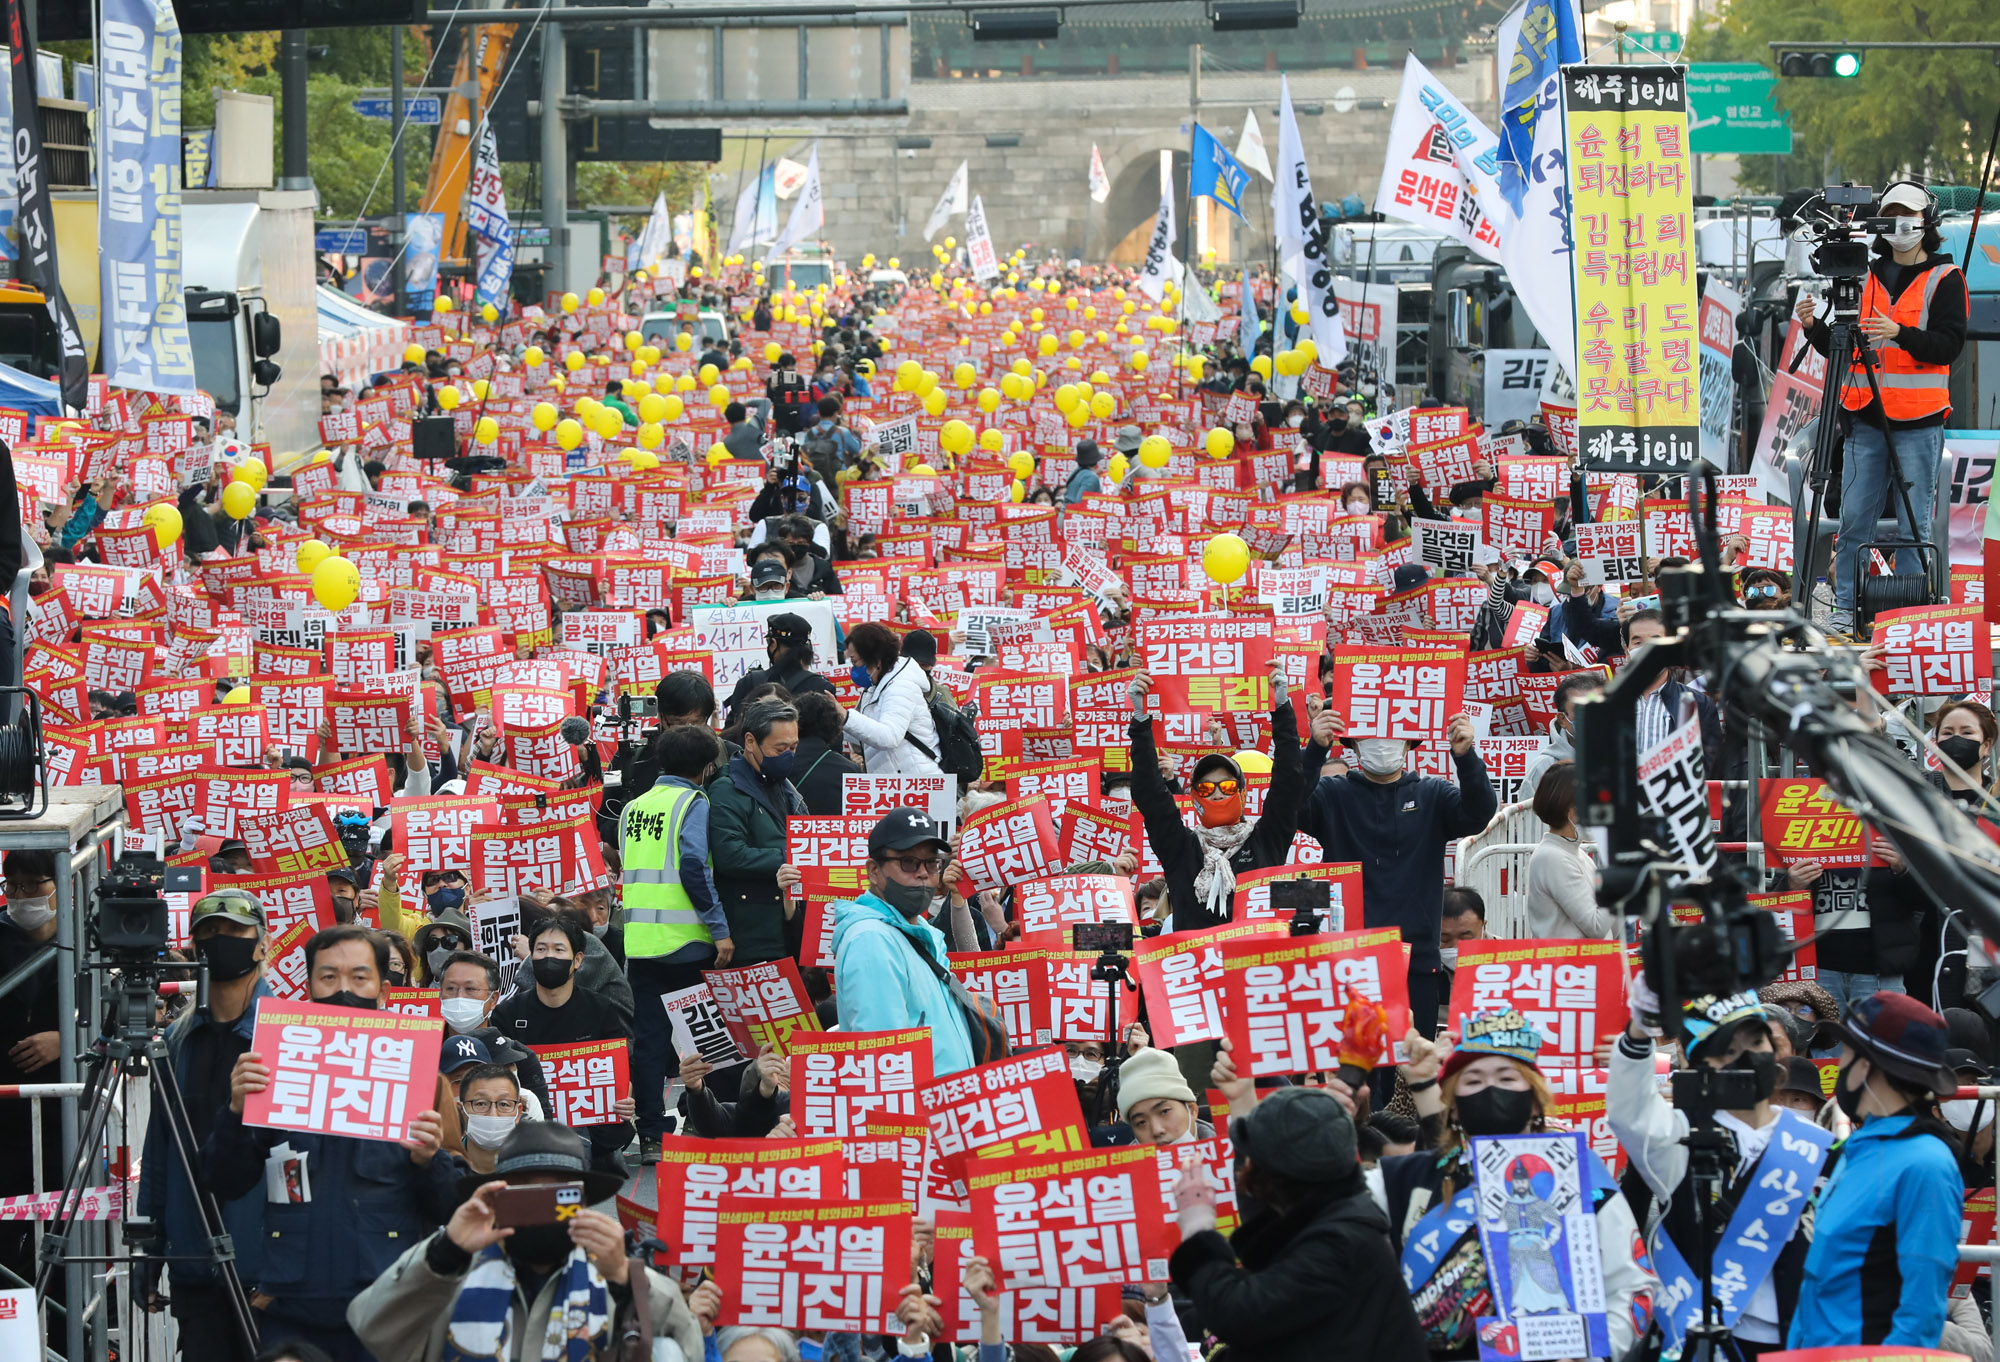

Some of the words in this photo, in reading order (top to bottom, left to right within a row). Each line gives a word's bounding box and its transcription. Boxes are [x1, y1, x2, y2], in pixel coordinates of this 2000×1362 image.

[475, 33, 489, 67] KATO
[1577, 161, 1685, 197] 퇴진하라
[1395, 168, 1458, 220] 윤석열
[1584, 377, 1693, 413] 못살쿠다
[878, 424, 911, 442] 김건희
[1416, 416, 1460, 432] 윤석열
[1418, 443, 1470, 469] 윤석열
[1507, 464, 1557, 481] 윤석열
[1729, 477, 1757, 488] 거짓말
[575, 481, 612, 496] 윤석열
[641, 492, 680, 506] 윤석열
[849, 488, 888, 502] 윤석열
[1285, 504, 1328, 522] 윤석열
[1489, 503, 1543, 525] 윤석열
[1008, 521, 1050, 543] 윤석열
[1422, 528, 1475, 551] 김건희
[1577, 526, 1592, 536] 무능
[1594, 524, 1613, 535] 무지
[882, 541, 925, 557] 윤석열
[1005, 550, 1061, 570] 윤석열
[1302, 542, 1356, 561] 윤석열
[1577, 535, 1637, 559] 윤석열
[613, 568, 663, 585] 윤석열
[1131, 564, 1180, 580] 윤석열
[490, 584, 540, 605] 윤석열
[614, 584, 664, 610] 퇴진!
[681, 585, 728, 605] 윤석열
[1260, 579, 1312, 596] 윤석열
[1434, 587, 1488, 606] 윤석열
[410, 603, 461, 620] 윤석열
[564, 615, 580, 624] 무능
[582, 614, 600, 623] 무지
[602, 614, 627, 624] 거짓말
[564, 624, 617, 641] 윤석열
[1146, 623, 1210, 641] 주가조작
[1213, 620, 1273, 639] 허위경력
[1884, 620, 1974, 654] 윤석열
[85, 641, 146, 670] 윤석열
[1002, 651, 1074, 675] 윤석열
[1146, 642, 1244, 675] 김건희
[1350, 664, 1446, 699] 윤석열
[1885, 652, 1975, 693] 퇴진!
[143, 689, 200, 715] 윤석열
[260, 684, 324, 709] 윤석열
[989, 685, 1054, 708] 윤석열
[1187, 675, 1270, 712] 특검!
[198, 714, 261, 739] 윤석열
[334, 705, 398, 732] 윤석열
[1075, 711, 1118, 723] 주가조작
[1348, 698, 1445, 740] 퇴진!
[1479, 739, 1504, 753] 무지
[1506, 738, 1539, 753] 거짓말
[208, 780, 279, 809] 윤석열
[845, 777, 872, 791] 무능
[875, 777, 903, 791] 무지
[906, 777, 945, 791] 거짓말
[1019, 772, 1089, 799] 윤석열
[239, 818, 257, 830] 무능
[259, 814, 276, 828] 무지
[276, 807, 311, 823] 거짓말
[406, 809, 484, 836] 윤석열
[790, 819, 846, 835] 주가조작
[243, 816, 330, 860] 윤석열
[960, 812, 1040, 856] 윤석열
[1780, 817, 1865, 848] 퇴진!!
[483, 835, 561, 866] 윤석열
[961, 839, 1049, 891] 퇴진!
[1022, 882, 1047, 897] 무능
[1050, 877, 1075, 892] 무지
[1079, 874, 1117, 892] 거짓말
[1022, 888, 1130, 933] 윤석열
[705, 972, 724, 988] 무능
[725, 972, 745, 985] 무지
[745, 964, 781, 982] 거짓말
[1243, 955, 1382, 1014] 윤석열
[1472, 964, 1597, 1010] 윤석열
[712, 977, 801, 1023] 윤석열
[258, 1012, 303, 1026] 민생파탄
[305, 1014, 349, 1028] 정치보복
[352, 1017, 396, 1030] 평화파괴
[398, 1019, 444, 1033] 친일매국
[277, 1025, 414, 1082] 윤석열
[791, 1044, 819, 1056] 민생파탄
[820, 1038, 855, 1054] 정치보복
[858, 1037, 892, 1052] 평화파괴
[894, 1028, 932, 1044] 친일매국
[540, 1055, 614, 1088] 윤석열
[804, 1050, 914, 1093] 윤석열
[983, 1050, 1068, 1091] 허위경력
[268, 1070, 408, 1140] 퇴진!
[920, 1075, 982, 1110] 주가조작
[929, 1087, 1043, 1160] 김건희
[969, 1173, 1012, 1190] 민생파탄
[1015, 1163, 1059, 1180] 정치보복
[1062, 1154, 1107, 1173] 평화파괴
[1110, 1145, 1156, 1165] 친일매국
[683, 1163, 821, 1216] 윤석열
[993, 1173, 1136, 1232] 윤석열
[718, 1210, 765, 1225] 민생파탄
[769, 1207, 814, 1224] 정치보복
[819, 1204, 864, 1220] 평화파괴
[867, 1201, 913, 1218] 친일매국
[741, 1223, 884, 1273] 윤석열
[998, 1222, 1143, 1289] 퇴진!
[737, 1271, 882, 1333] 퇴진!
